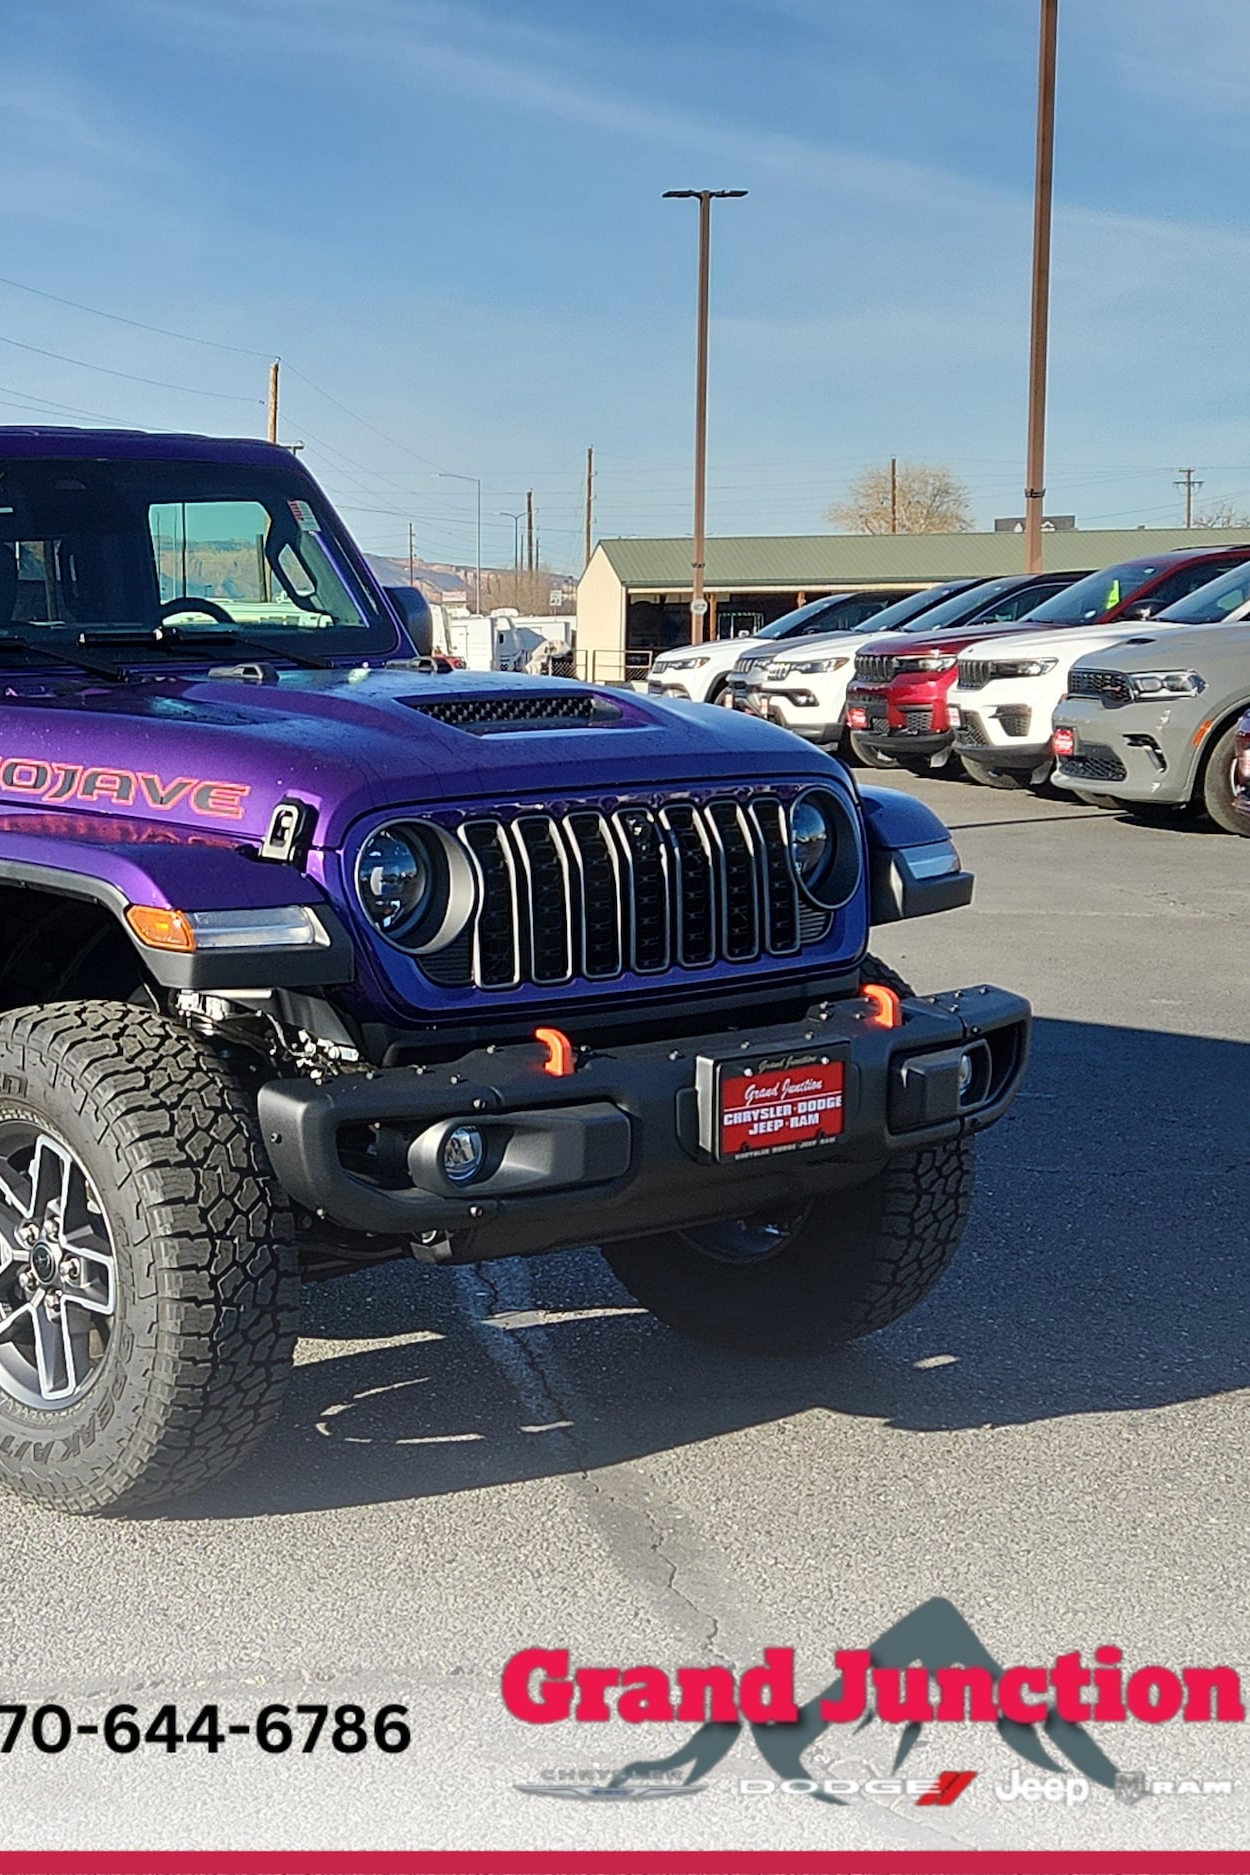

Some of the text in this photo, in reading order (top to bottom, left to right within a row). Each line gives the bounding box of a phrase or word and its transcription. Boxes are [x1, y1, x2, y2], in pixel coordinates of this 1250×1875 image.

[744, 1078, 823, 1106] Grand Junction
[723, 1095, 843, 1126] CHRYSLER DODGE
[748, 1112, 820, 1136] JEEP RAM
